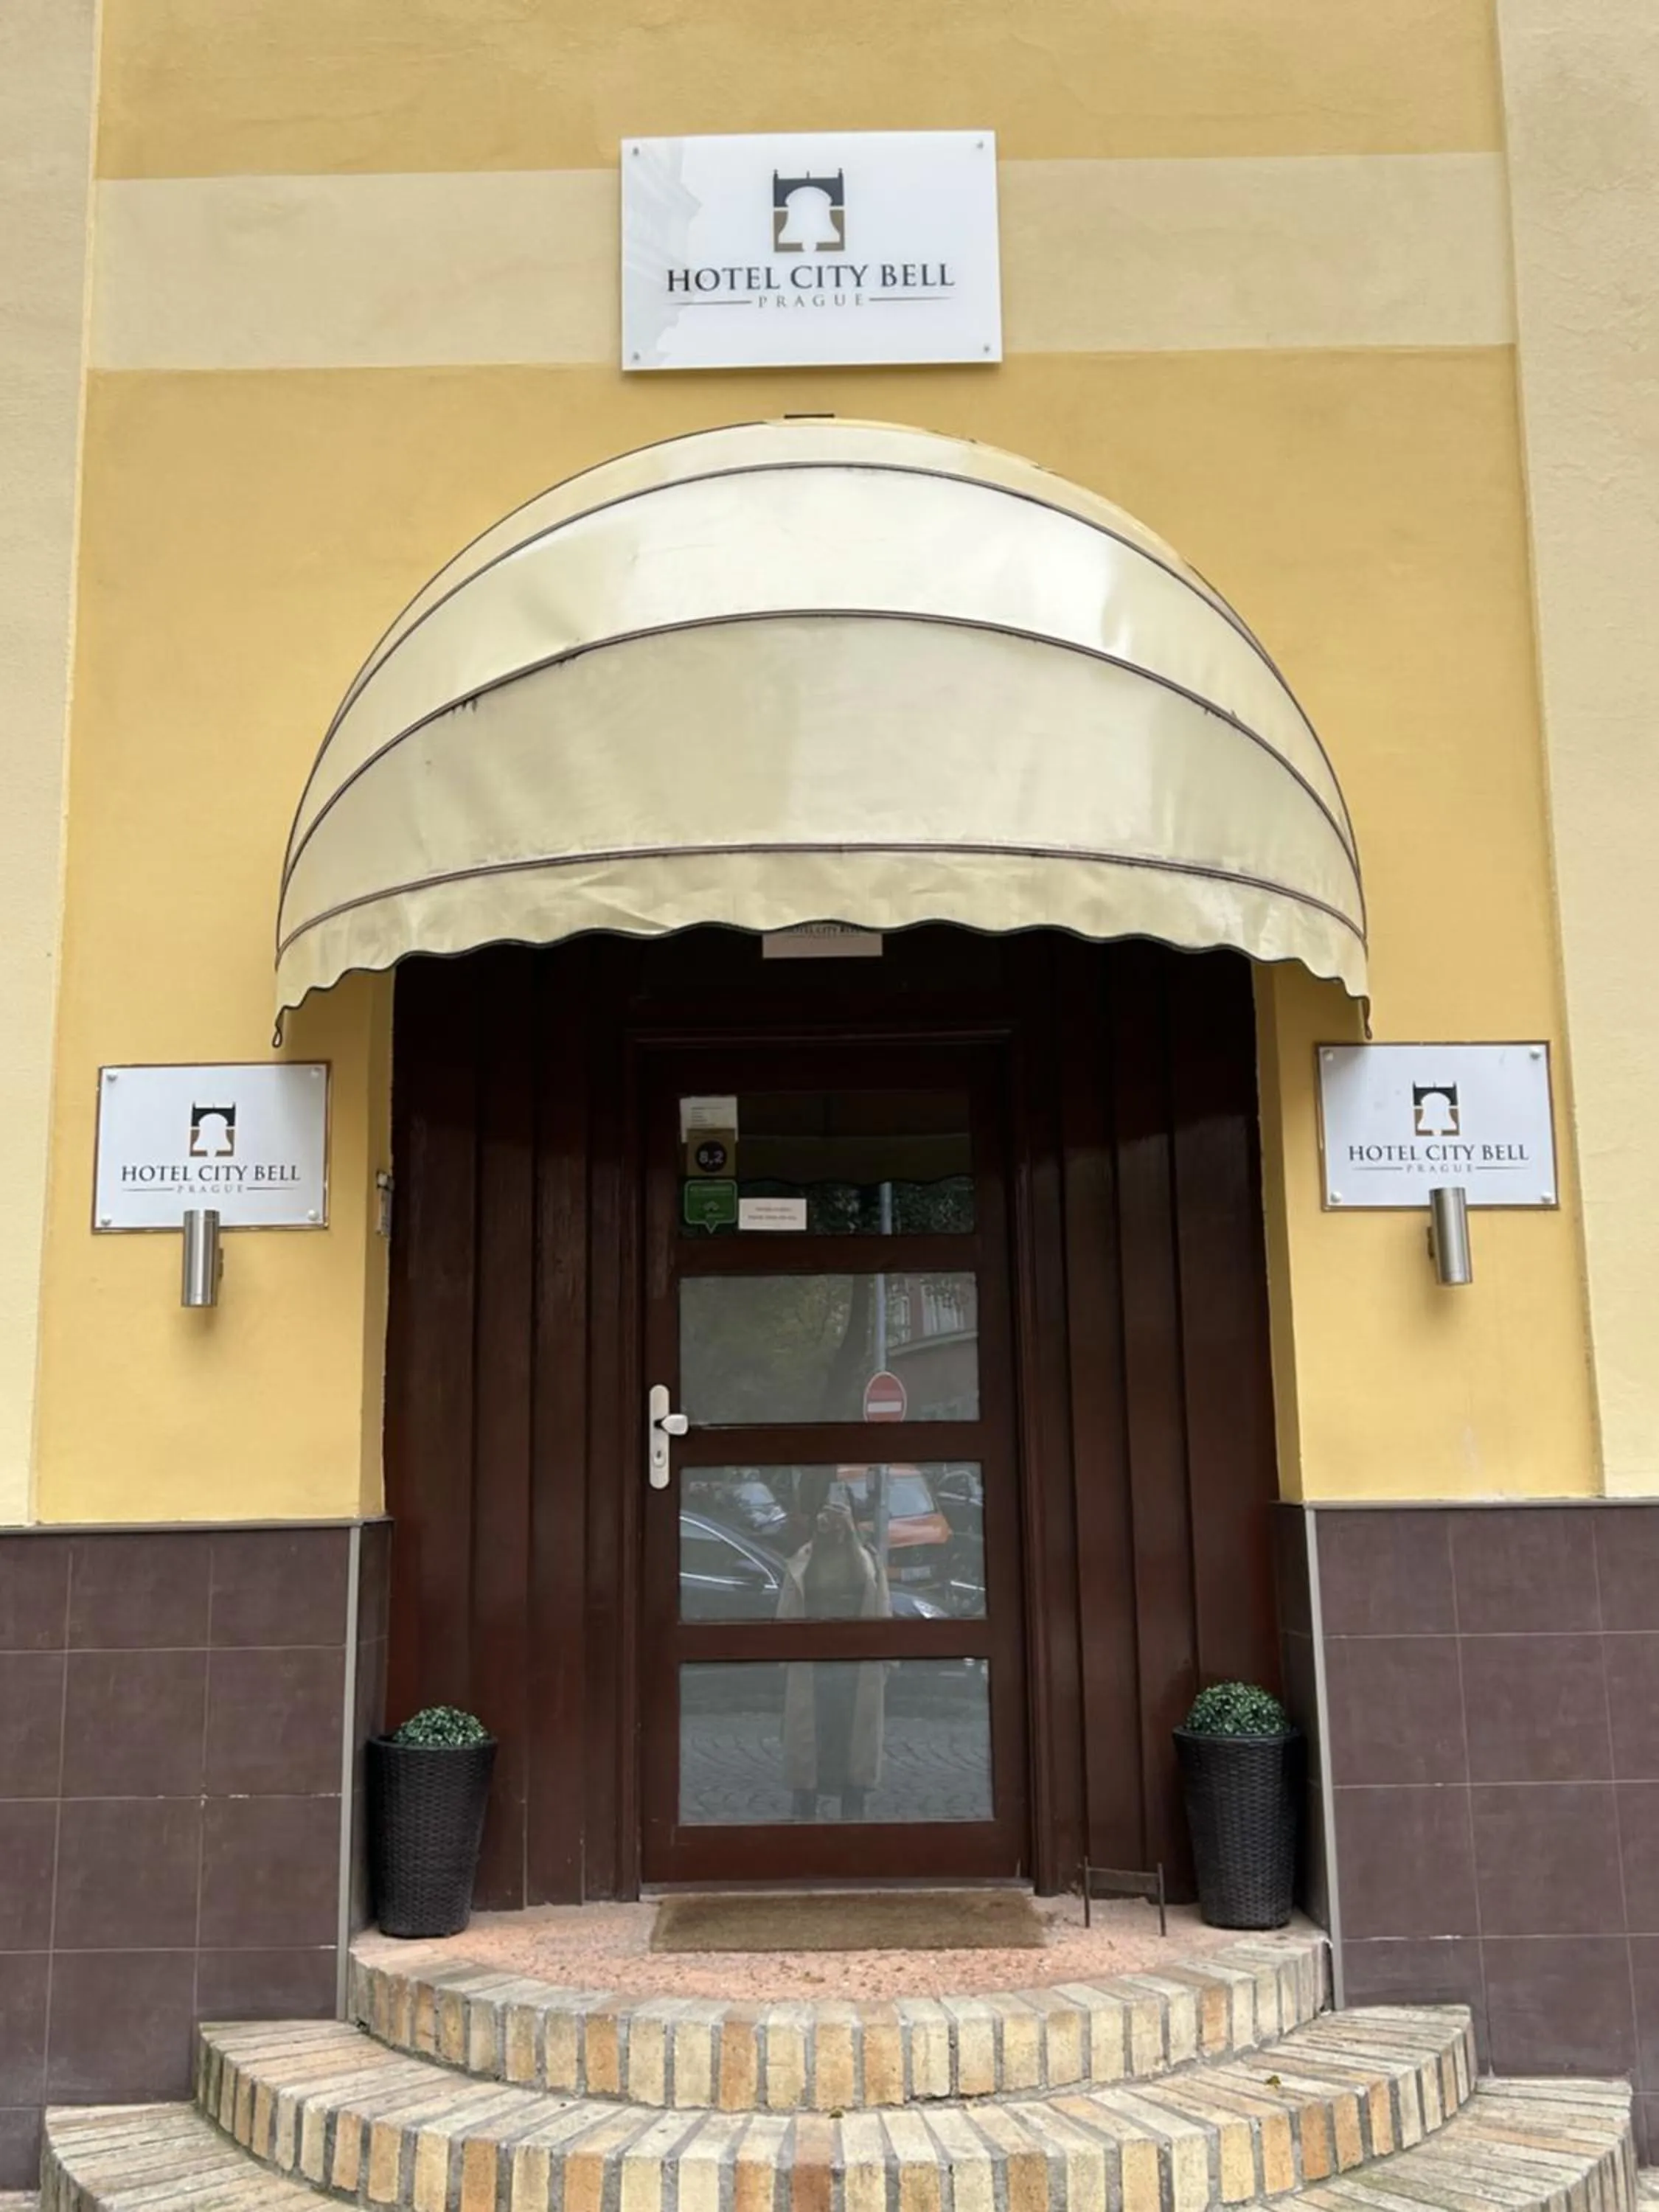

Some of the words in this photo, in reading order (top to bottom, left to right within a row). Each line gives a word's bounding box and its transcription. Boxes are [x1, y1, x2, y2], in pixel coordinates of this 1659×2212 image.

[667, 268, 780, 292] HOTEL
[790, 265, 868, 288] CITY
[880, 263, 956, 287] BELL
[758, 293, 863, 308] PRAGUE
[1349, 1145, 1420, 1161] HOTEL
[1425, 1144, 1475, 1161] CITY
[1482, 1144, 1529, 1161] BELL
[122, 1165, 192, 1182] HOTEL
[198, 1165, 247, 1181] CITY
[254, 1165, 301, 1181] BELL
[1406, 1163, 1473, 1173] PRAGUE
[177, 1184, 243, 1193] PRAGUE
